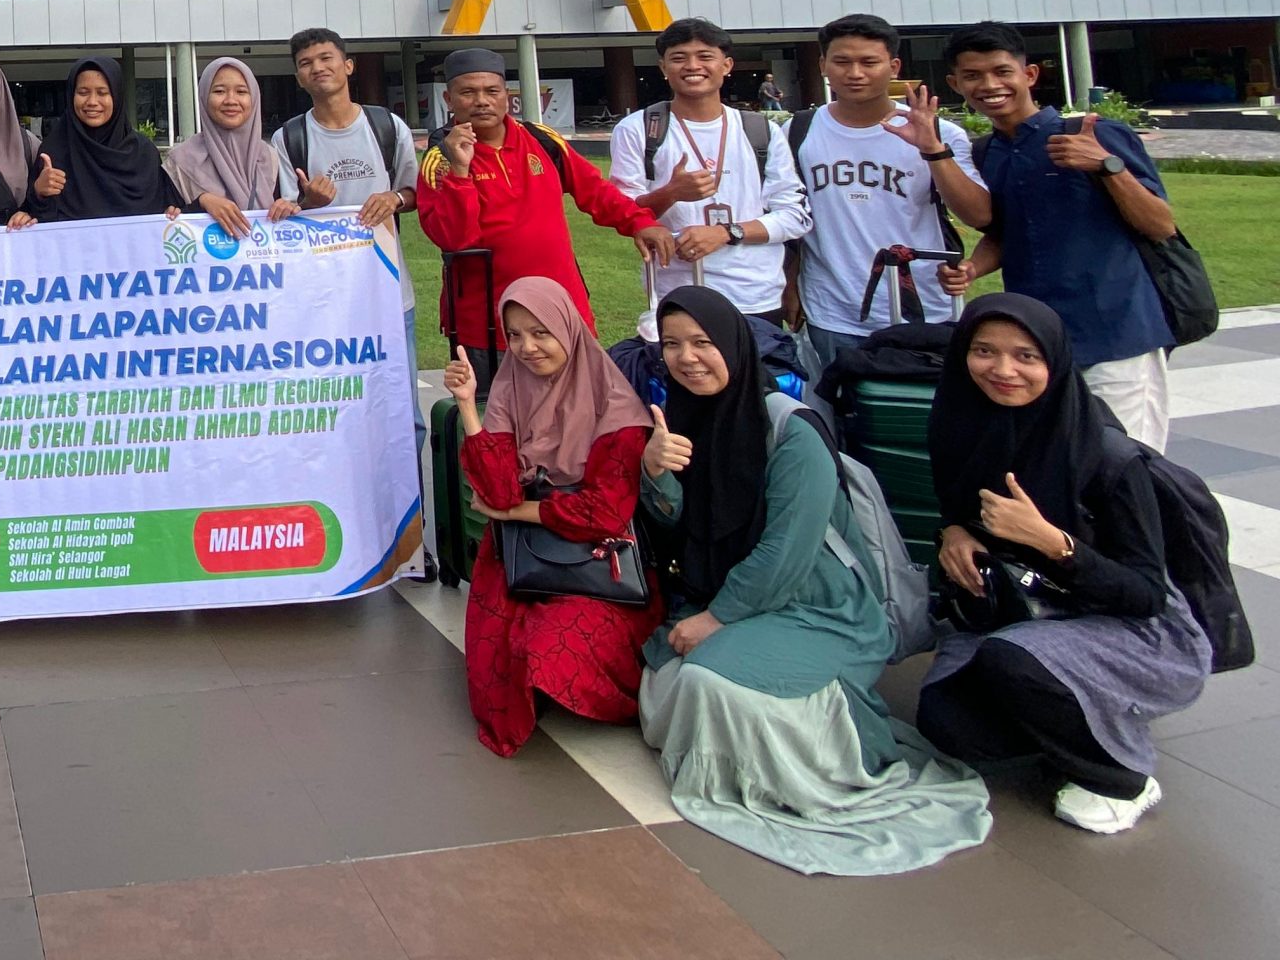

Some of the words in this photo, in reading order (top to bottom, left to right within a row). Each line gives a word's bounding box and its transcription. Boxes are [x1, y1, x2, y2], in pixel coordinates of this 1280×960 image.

[331, 158, 364, 171] FRANCISCO
[363, 163, 375, 176] CITY
[333, 170, 366, 180] PREMIUM
[811, 160, 907, 198] DGCK
[274, 228, 304, 242] ISO
[246, 248, 279, 258] pusaka
[79, 267, 202, 300] NYATA
[208, 263, 283, 292] DAN
[70, 303, 268, 341] LAPANGAN
[116, 335, 387, 378] INTERNASIONAL
[86, 386, 172, 417] TARBIYAH
[179, 384, 216, 411] DAN
[222, 381, 268, 408] ILMU
[274, 375, 363, 406] KEGURUAN
[28, 420, 86, 449] SYEKH
[91, 419, 121, 446] ALI
[127, 415, 188, 444] HASAN
[194, 411, 261, 440] AHMAD
[268, 406, 339, 436] ADDARY
[7, 520, 49, 535] Sekolah
[52, 519, 62, 533] Al
[65, 518, 90, 532] Amin
[94, 516, 135, 530] Gombak
[8, 536, 49, 551] Sekolah
[52, 535, 63, 548] Al
[65, 533, 107, 548] Hidayah
[111, 532, 134, 547] Ipoh
[209, 522, 305, 553] MALAYSIA
[9, 553, 28, 567] SMI
[58, 550, 106, 565] Selangor
[10, 569, 52, 583] Sekolah
[55, 567, 64, 580] di
[68, 566, 92, 579] Hulu
[95, 564, 131, 578] Langat
